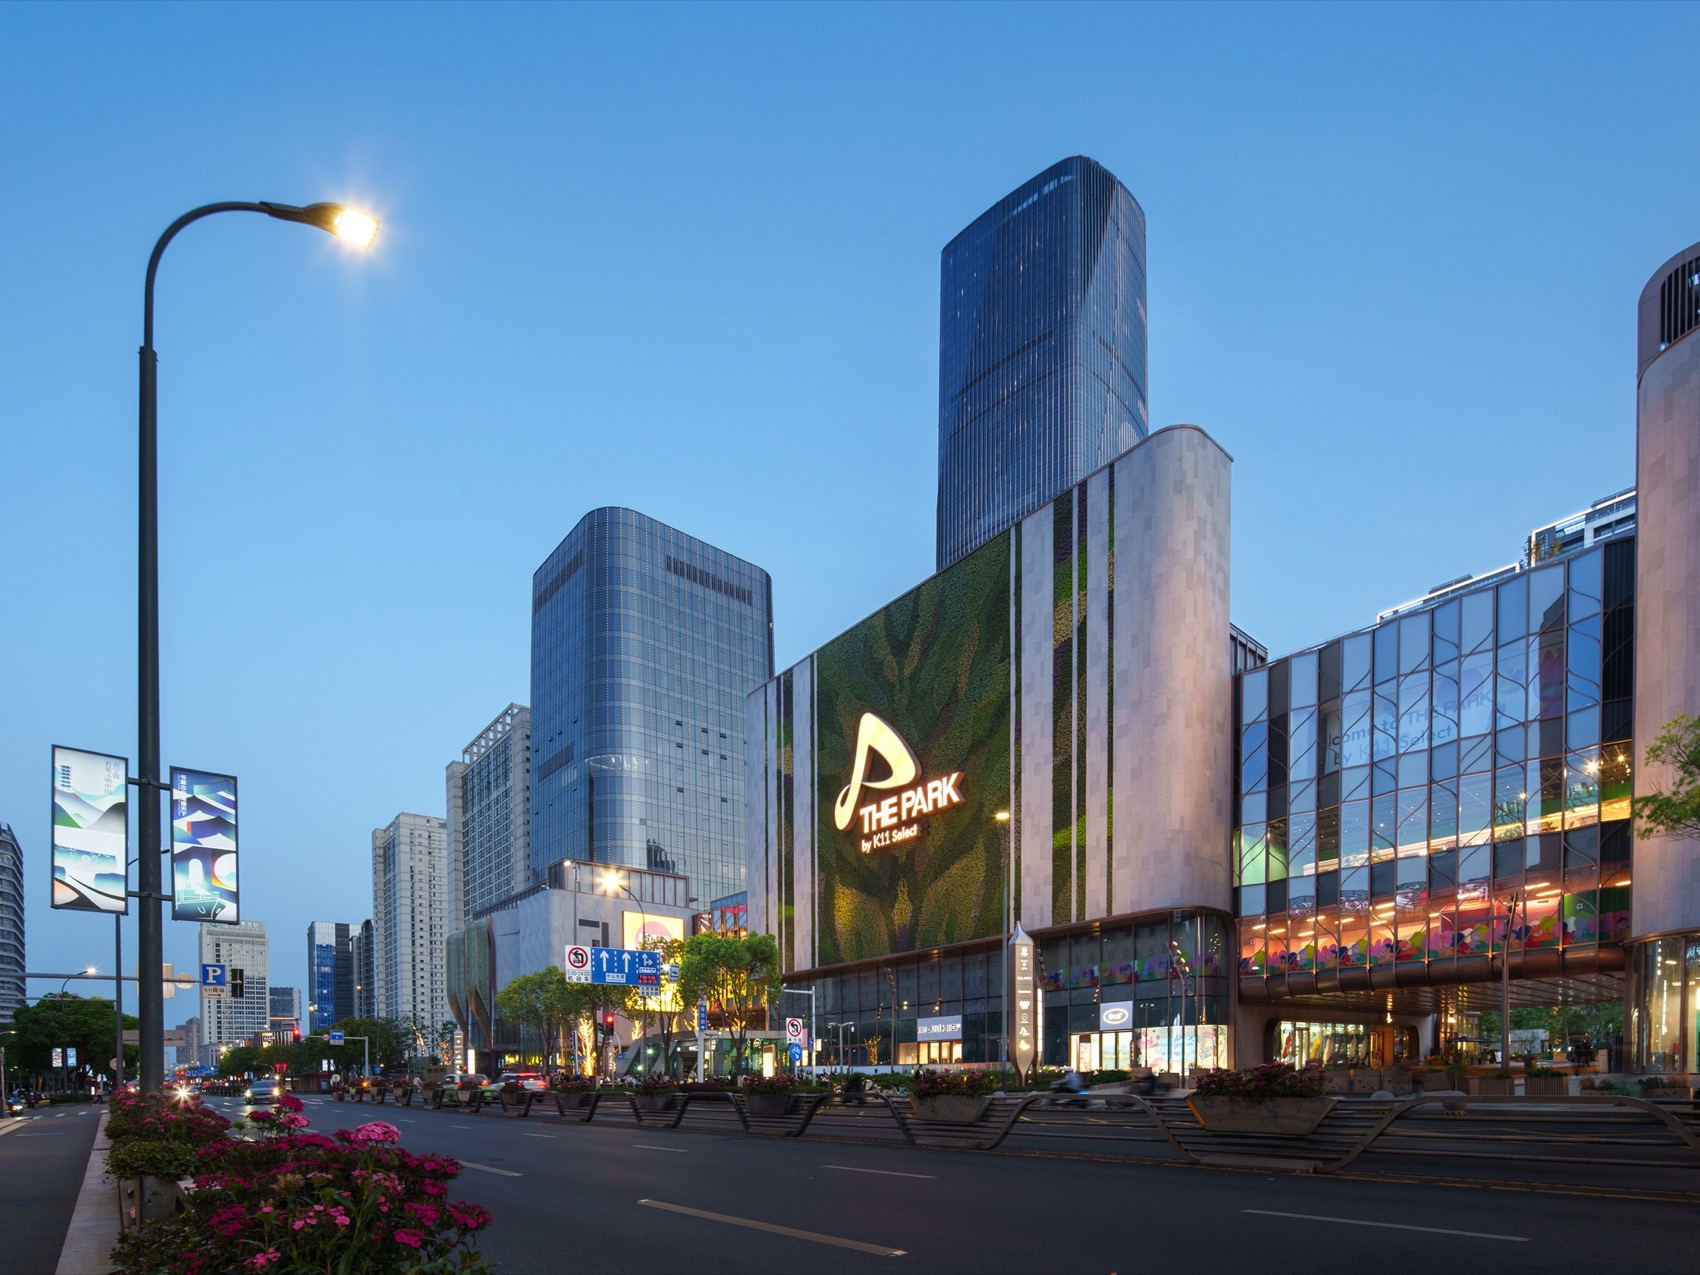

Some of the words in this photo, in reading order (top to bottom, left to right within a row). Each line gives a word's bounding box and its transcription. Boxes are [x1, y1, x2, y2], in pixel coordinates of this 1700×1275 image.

[1381, 719, 1398, 732] to
[1444, 689, 1493, 715] PARK
[1400, 725, 1452, 749] Select
[860, 796, 897, 833] THE
[902, 771, 961, 820] PARK
[861, 839, 872, 853] by
[873, 830, 891, 848] K11
[892, 823, 918, 843] Select
[206, 966, 221, 983] P
